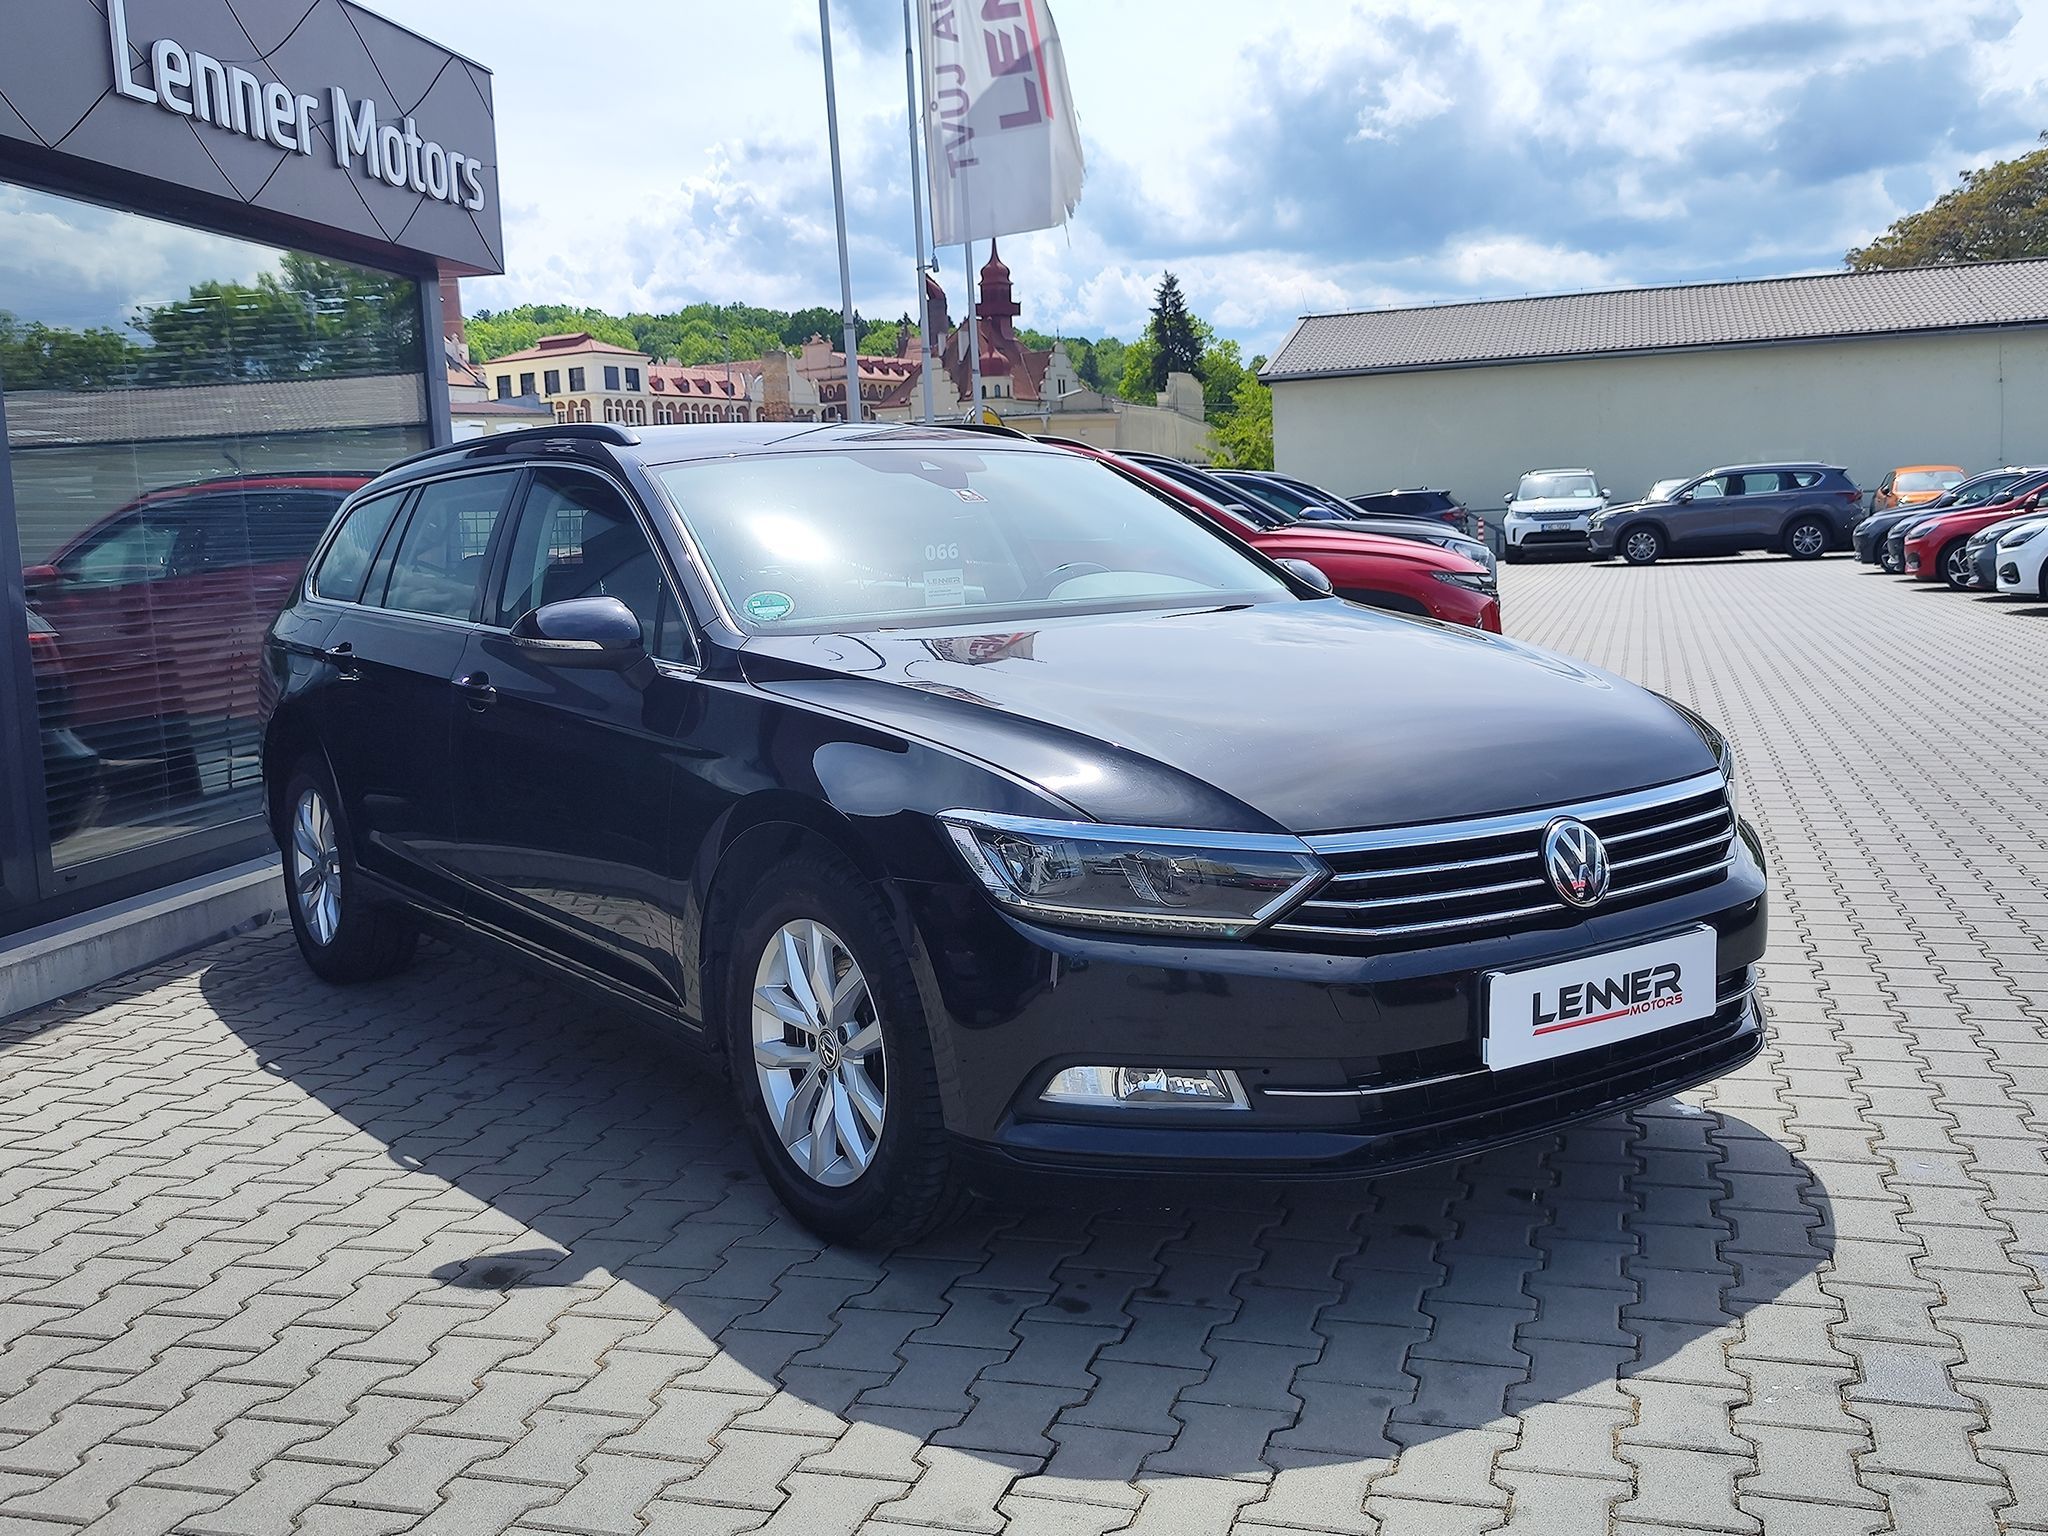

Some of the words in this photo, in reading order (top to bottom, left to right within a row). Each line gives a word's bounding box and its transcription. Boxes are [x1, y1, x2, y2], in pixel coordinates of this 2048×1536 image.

[106, 0, 318, 157] Lenner
[330, 86, 485, 212] Motors
[931, 64, 980, 178] TVŮJ
[924, 542, 959, 561] 066
[1532, 962, 1683, 1026] LENNER
[1629, 993, 1683, 1016] MOTORS
